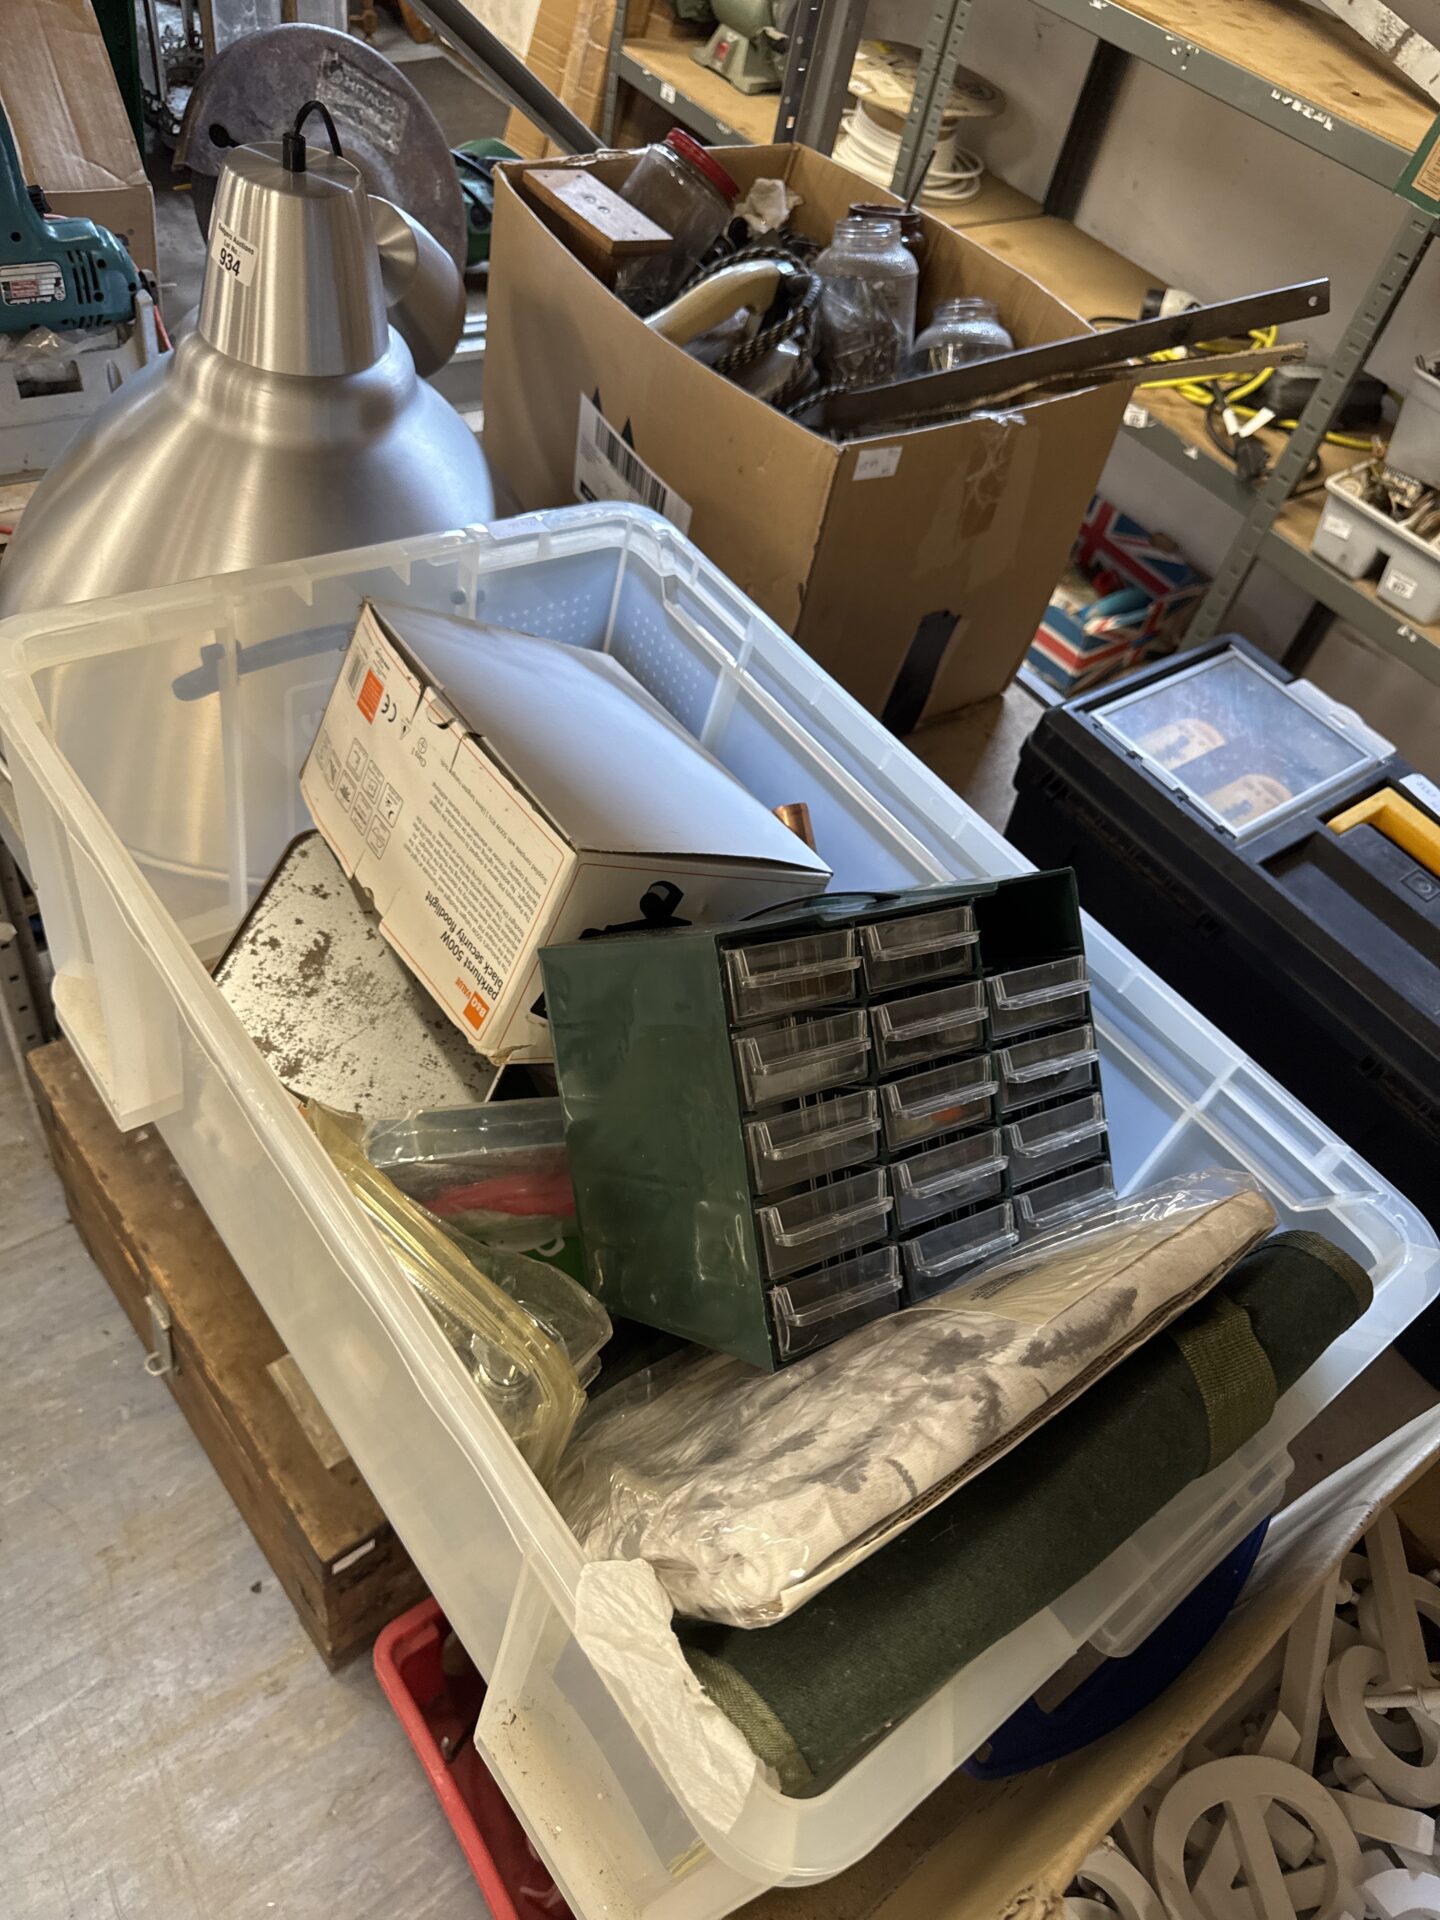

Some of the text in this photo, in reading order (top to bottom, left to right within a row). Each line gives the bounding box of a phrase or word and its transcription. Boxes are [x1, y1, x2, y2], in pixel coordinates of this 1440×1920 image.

[233, 236, 254, 255] Auctions
[219, 248, 241, 276] 934
[413, 749, 426, 768] Class
[424, 890, 503, 991] black security floodlight
[439, 930, 498, 1001] parkhurst 500W
[454, 976, 471, 1000] VALUE
